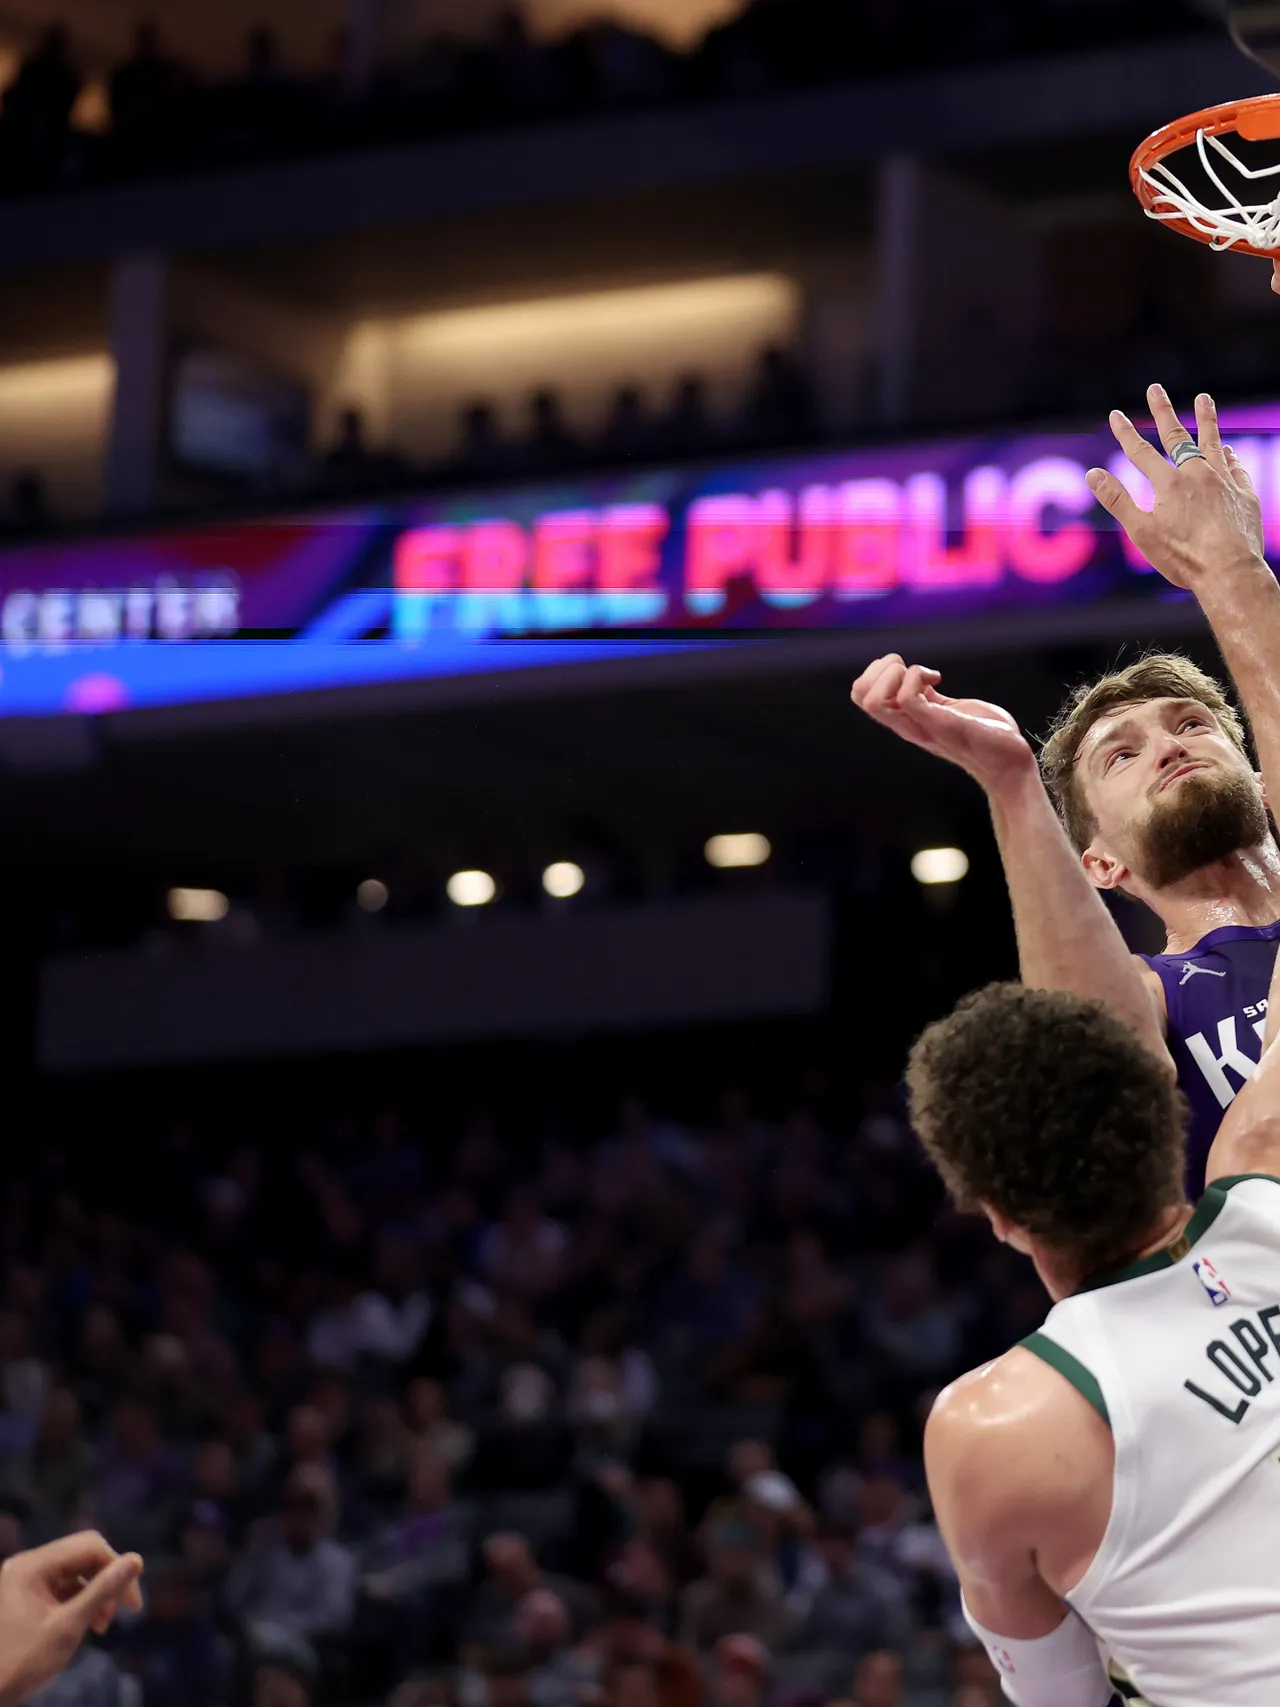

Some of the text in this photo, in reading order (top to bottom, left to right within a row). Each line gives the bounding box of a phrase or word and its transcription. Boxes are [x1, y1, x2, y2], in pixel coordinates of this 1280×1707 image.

[2, 572, 241, 659] CENTER
[393, 503, 669, 648] FREE
[684, 457, 1097, 616] PUBLIC
